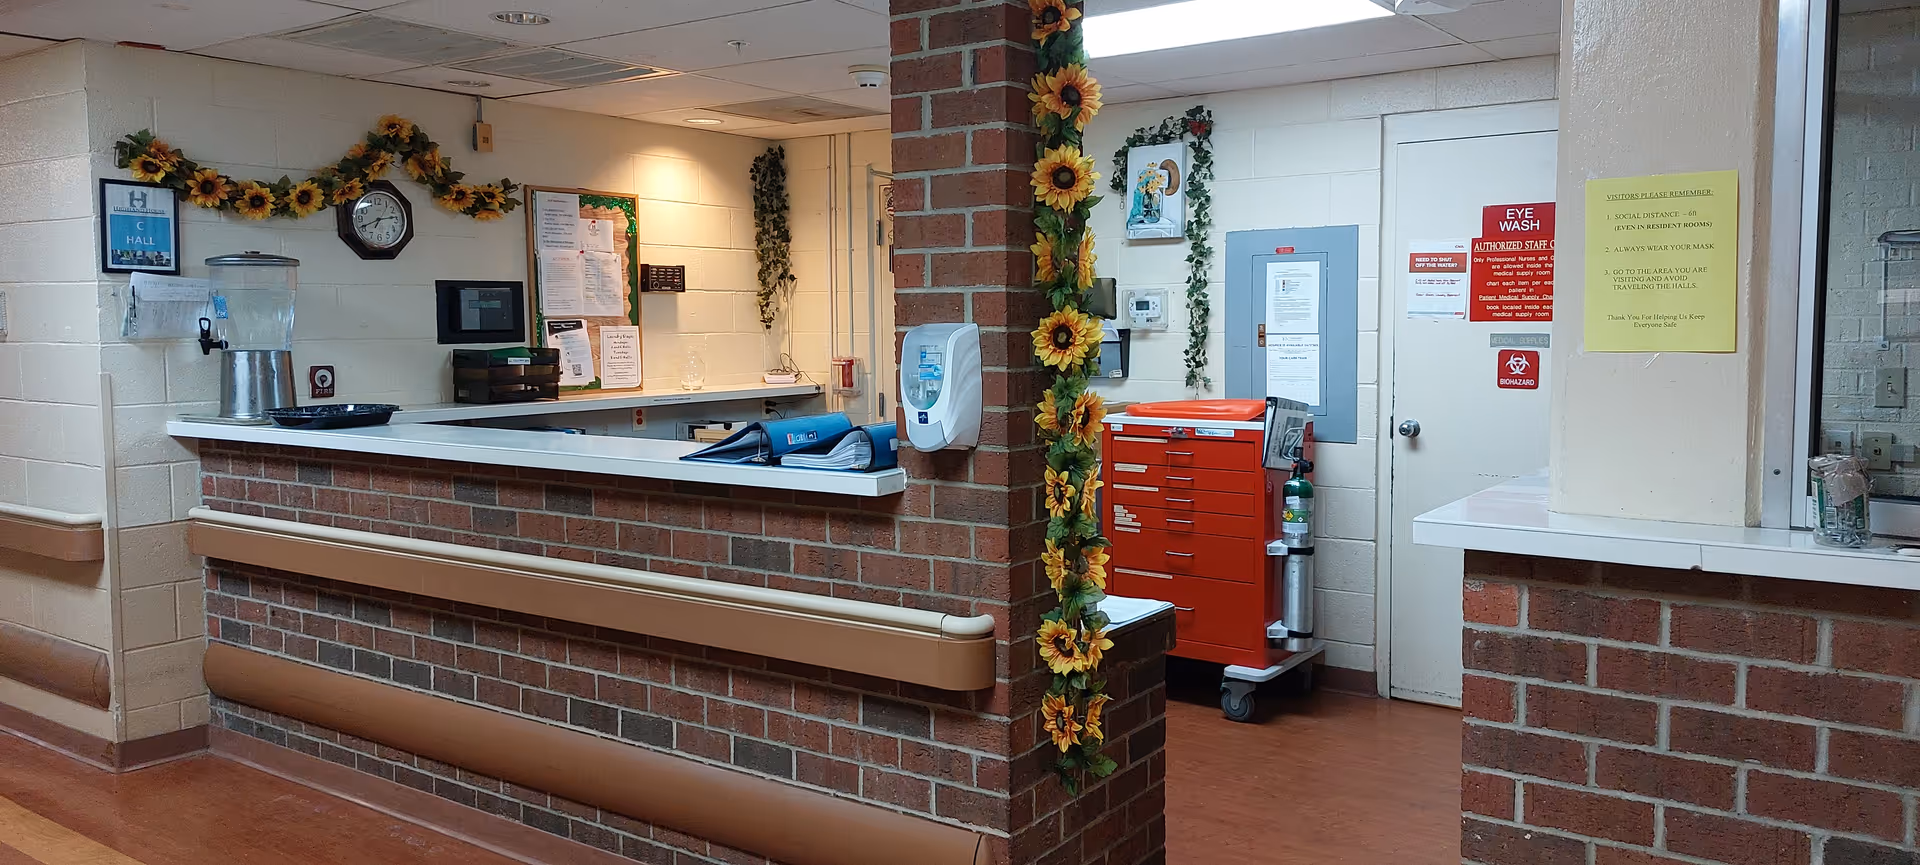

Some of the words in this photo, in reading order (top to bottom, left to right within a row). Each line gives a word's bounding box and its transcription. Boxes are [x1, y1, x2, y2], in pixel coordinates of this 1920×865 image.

[1606, 192, 1640, 200] VISITORS
[1641, 191, 1667, 199] PLEASE
[1669, 189, 1714, 198] REMEMBER:
[373, 197, 382, 206] 12
[1506, 207, 1534, 220] EYE
[1615, 212, 1641, 220] SOCIAL
[1643, 211, 1680, 219] DISTANCE
[136, 221, 145, 232] C
[1498, 220, 1540, 232] WASH
[1614, 224, 1636, 232] (EVEN
[1683, 221, 1713, 229] ROOMS)
[126, 235, 156, 246] HALL
[376, 234, 382, 242] 6
[386, 232, 391, 240] 5
[1474, 241, 1522, 251] AUTHORIZED
[1524, 240, 1548, 250] STAFF
[1653, 313, 1678, 322] Helping
[1689, 313, 1706, 321] Keep
[1500, 378, 1535, 386] BIOHAZARD
